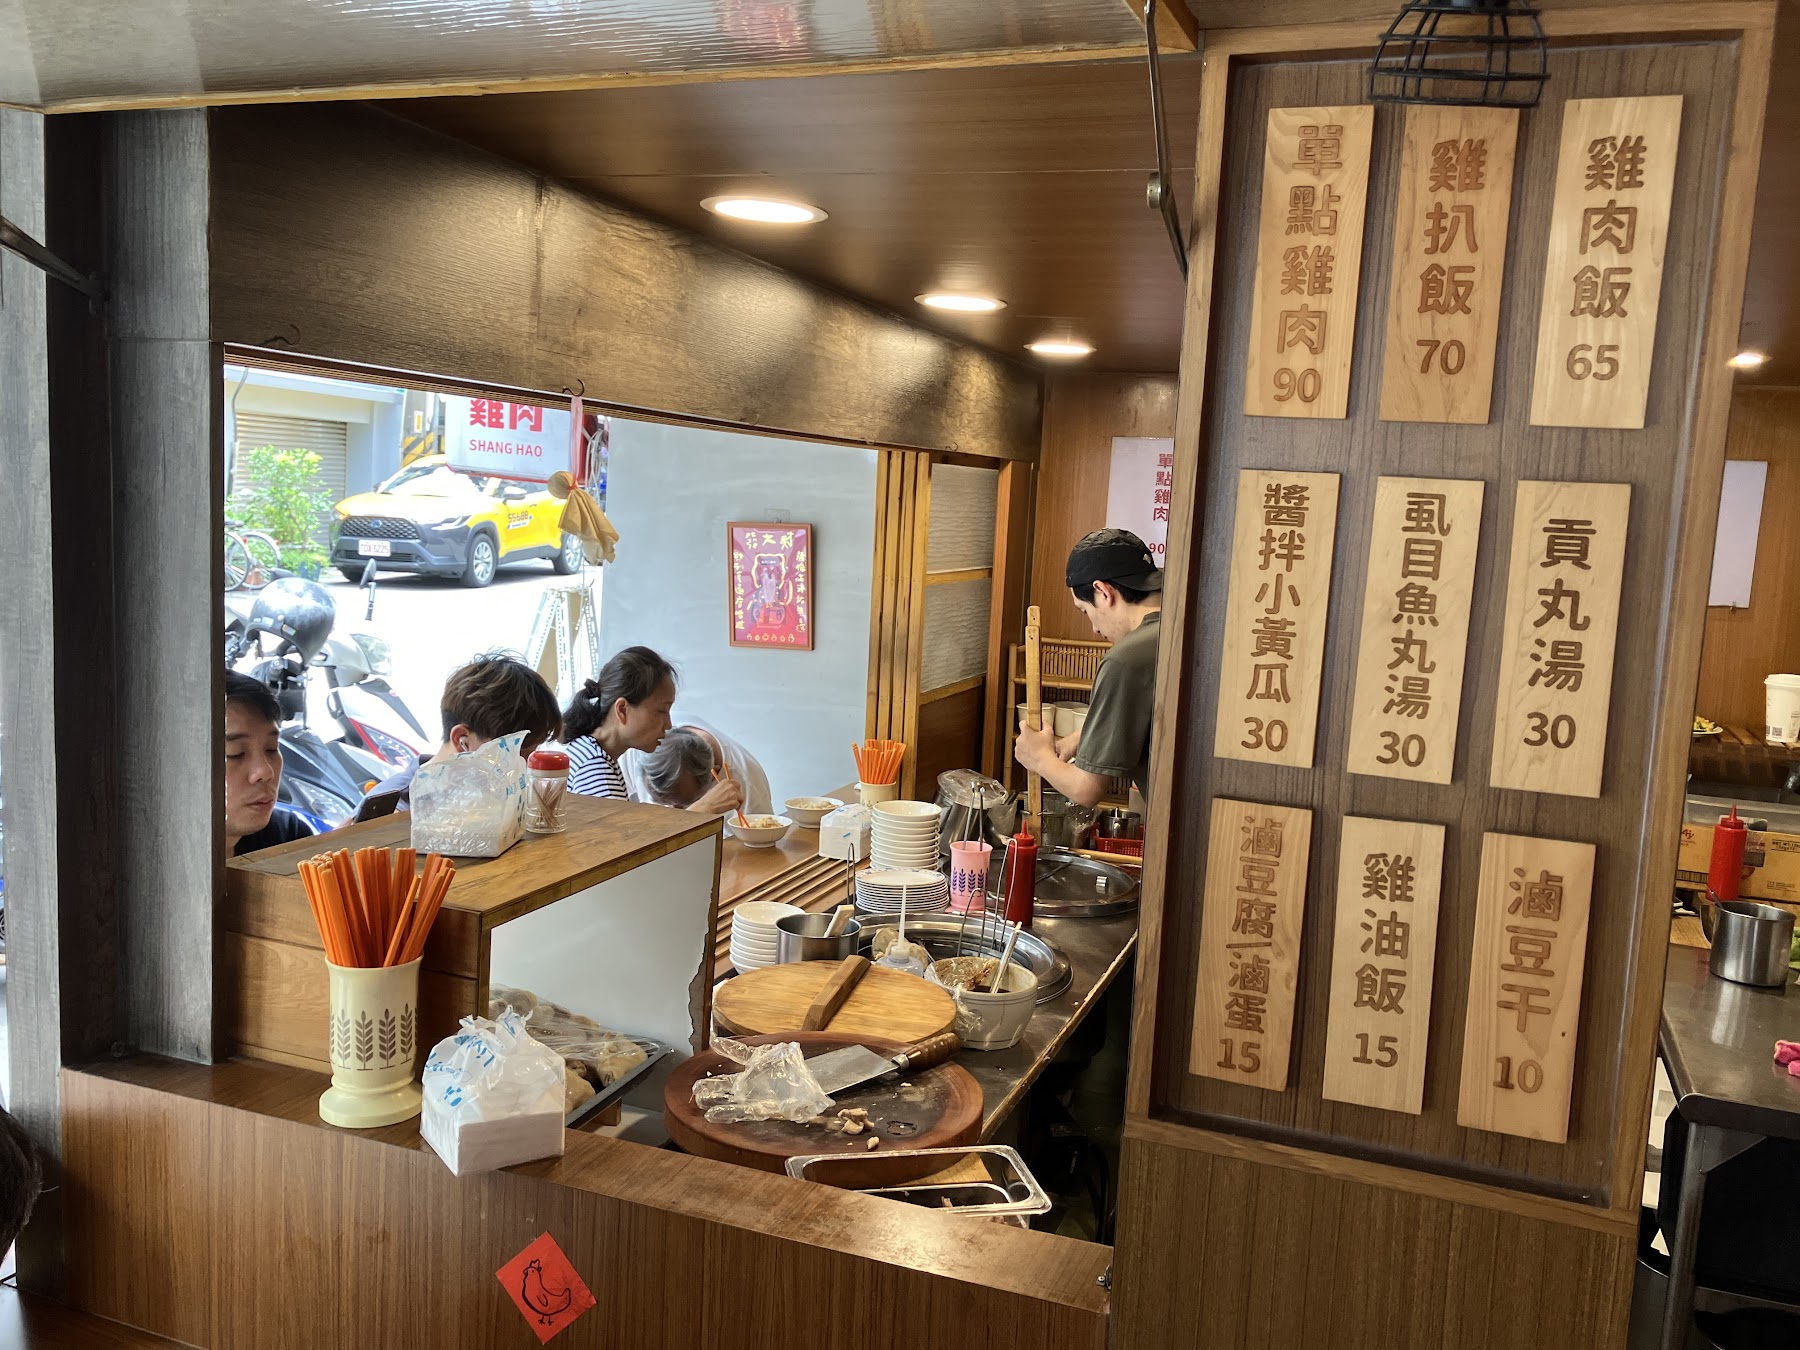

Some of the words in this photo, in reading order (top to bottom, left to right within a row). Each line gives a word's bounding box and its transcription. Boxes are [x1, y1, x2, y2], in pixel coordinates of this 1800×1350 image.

[1276, 124, 1344, 355] 單點雞肉
[1417, 138, 1488, 316] 雞扒飯
[1569, 135, 1647, 319] 雞肉飯
[1416, 339, 1466, 376] 70
[1566, 343, 1620, 381] 65
[1273, 367, 1322, 403] 90
[469, 398, 542, 432] 雞肉
[469, 439, 513, 455] SHANG
[516, 444, 543, 457] HAO
[1152, 453, 1173, 522] 單點雞肉
[1149, 542, 1165, 554] 90
[1246, 483, 1310, 704] 醬拌小黃瓜
[1382, 492, 1451, 720] 虱目魚丸湯
[1528, 518, 1597, 693] 貢丸湯
[1241, 716, 1289, 753] 30
[1376, 730, 1426, 768] 30
[1523, 711, 1577, 749] 30
[1353, 852, 1416, 1015] 雞油飯
[1496, 867, 1564, 1033] 滷豆干
[1216, 1037, 1261, 1074] 15
[1352, 1032, 1399, 1068] 15
[1492, 1055, 1544, 1094] 10
